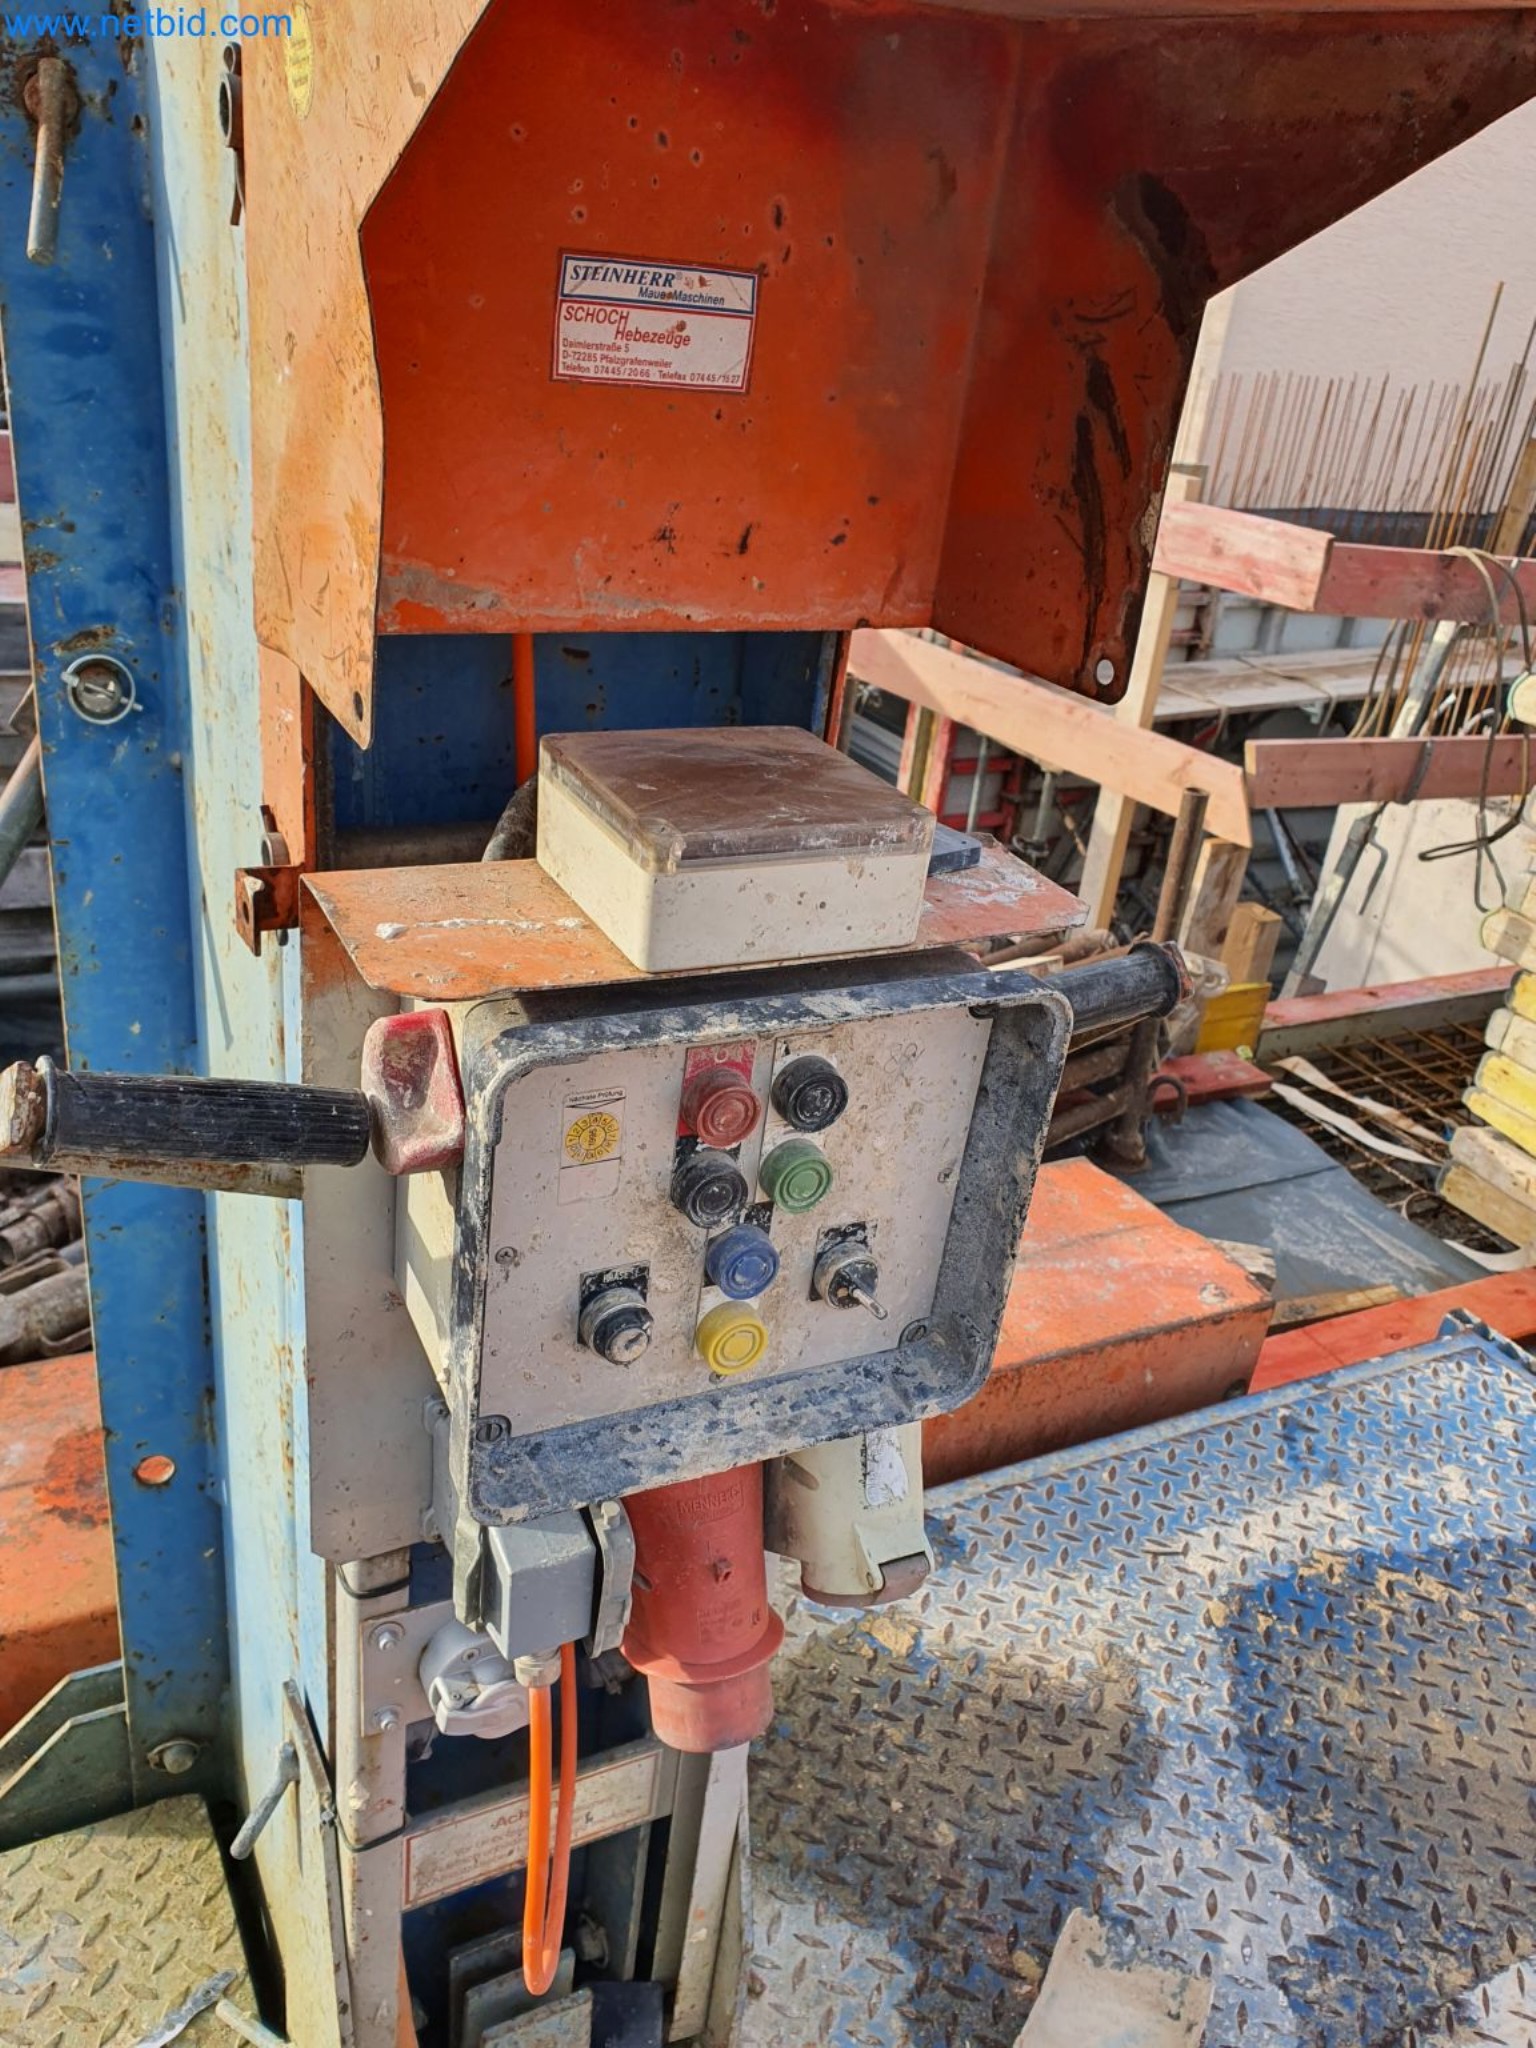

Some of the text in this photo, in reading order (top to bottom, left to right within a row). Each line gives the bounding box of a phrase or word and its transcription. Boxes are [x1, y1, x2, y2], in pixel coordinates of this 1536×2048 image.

[570, 264, 676, 288] STEINHERR
[563, 305, 630, 325] SCHOCH
[562, 338, 630, 352] Daimlerstraße 5
[614, 325, 691, 348] Hebezeuge
[562, 350, 673, 369] D-72285 Pfalzgrafenweiler
[562, 362, 590, 374] Telefon
[658, 370, 686, 381] Telefax
[597, 1089, 623, 1098] Prüfung
